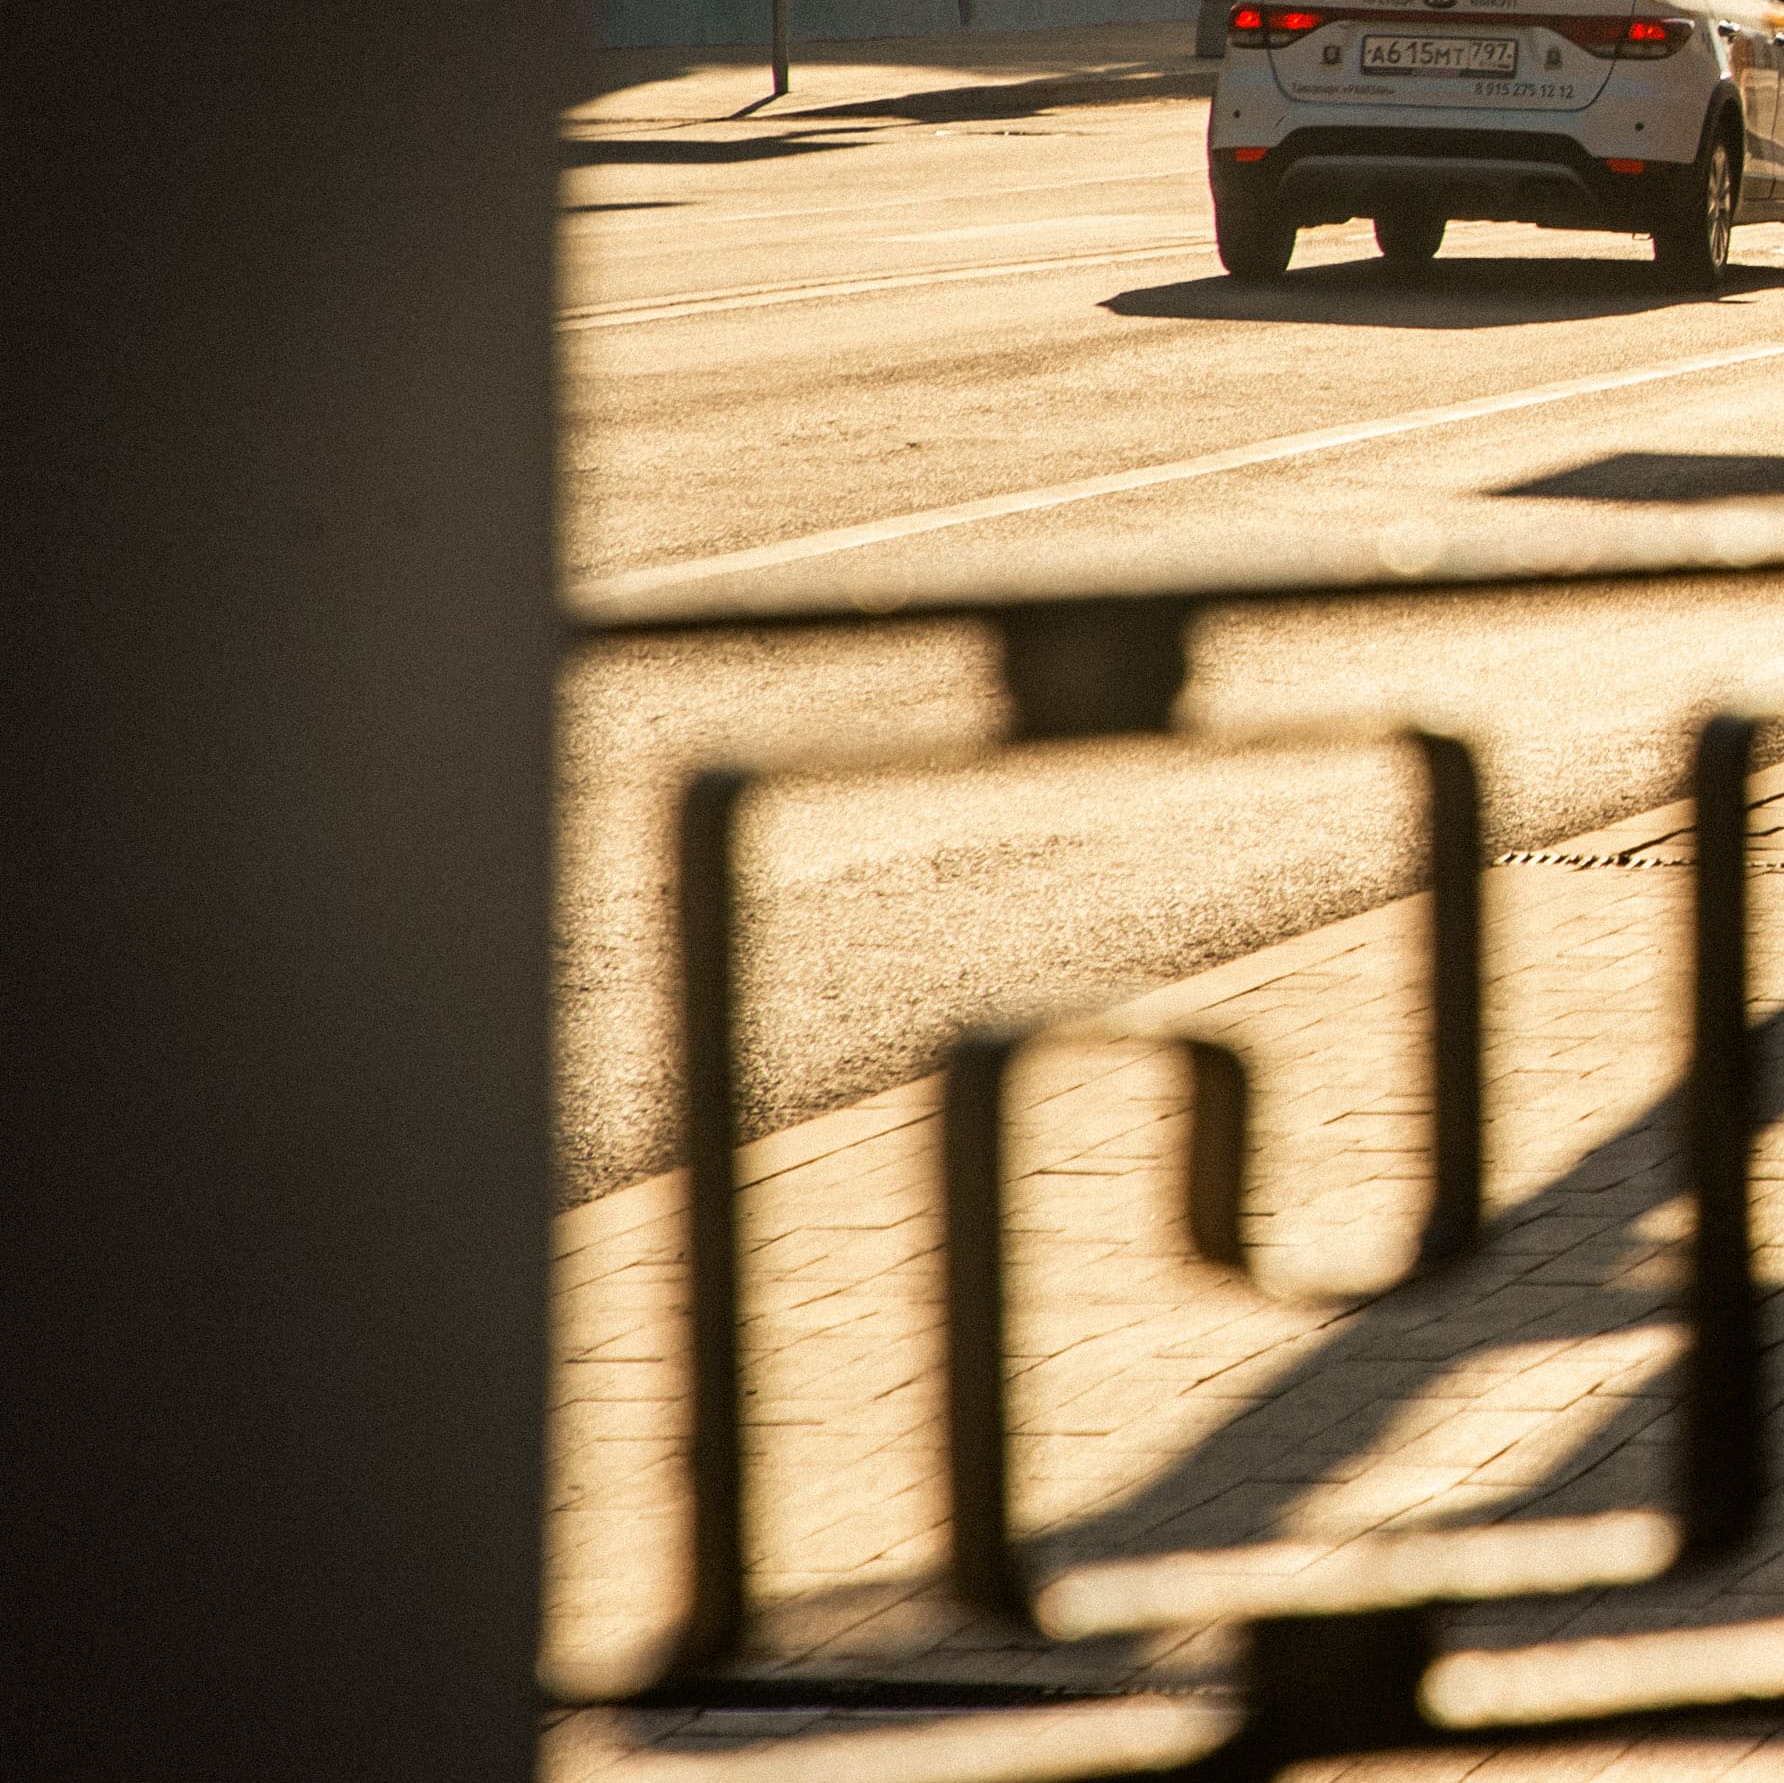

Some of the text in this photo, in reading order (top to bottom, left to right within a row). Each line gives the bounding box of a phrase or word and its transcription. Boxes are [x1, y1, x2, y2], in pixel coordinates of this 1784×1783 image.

[1474, 82, 1483, 95] 8
[1486, 82, 1510, 96] 915
[1541, 84, 1556, 98] 12
[1560, 85, 1575, 99] 12
